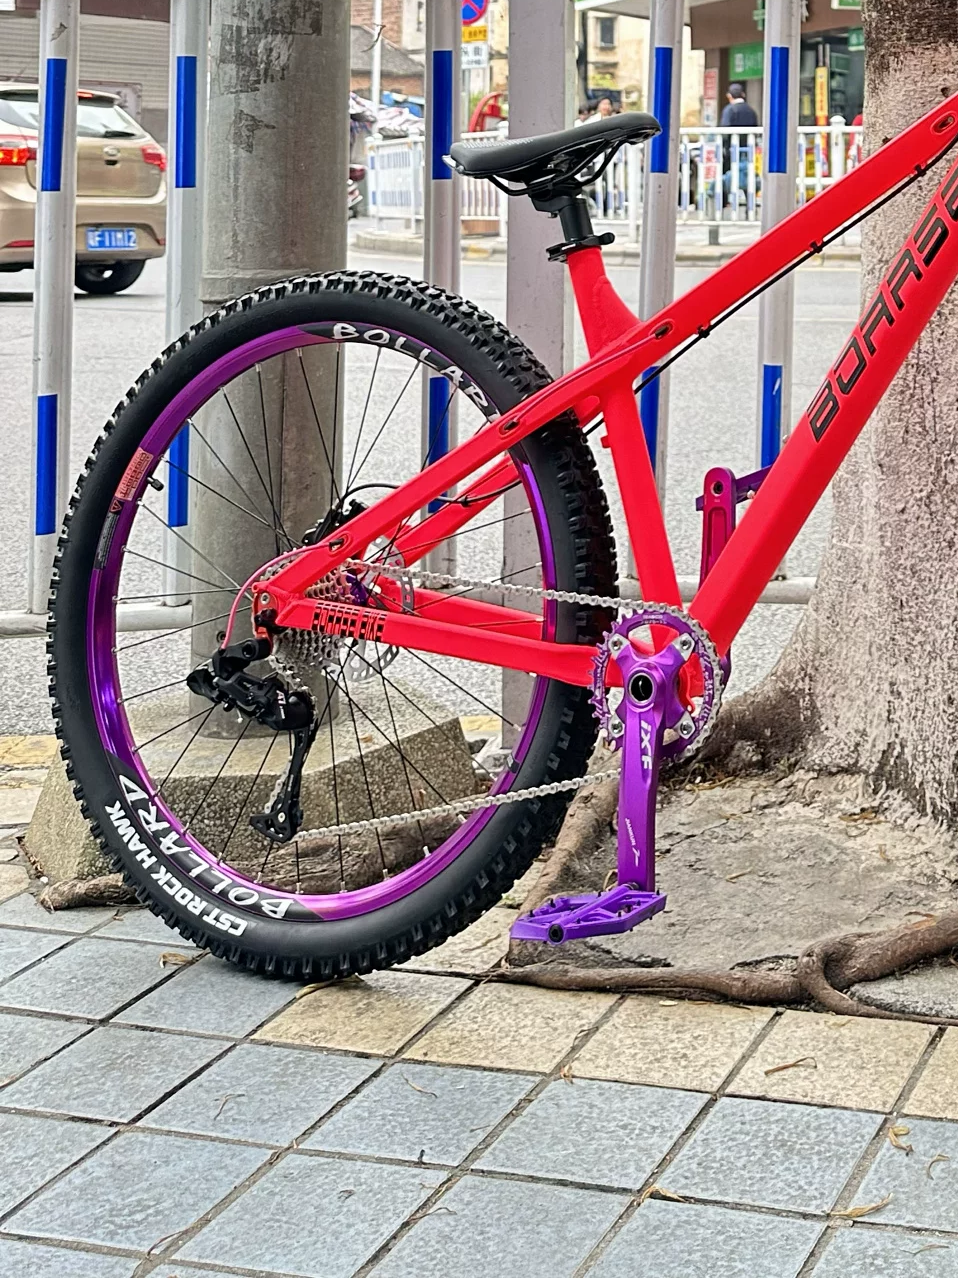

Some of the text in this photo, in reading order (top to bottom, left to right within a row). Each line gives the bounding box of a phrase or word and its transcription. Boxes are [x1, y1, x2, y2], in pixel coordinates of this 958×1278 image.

[104, 800, 249, 937] CST ROCK HAWK
[118, 774, 295, 919] BOLLARD
